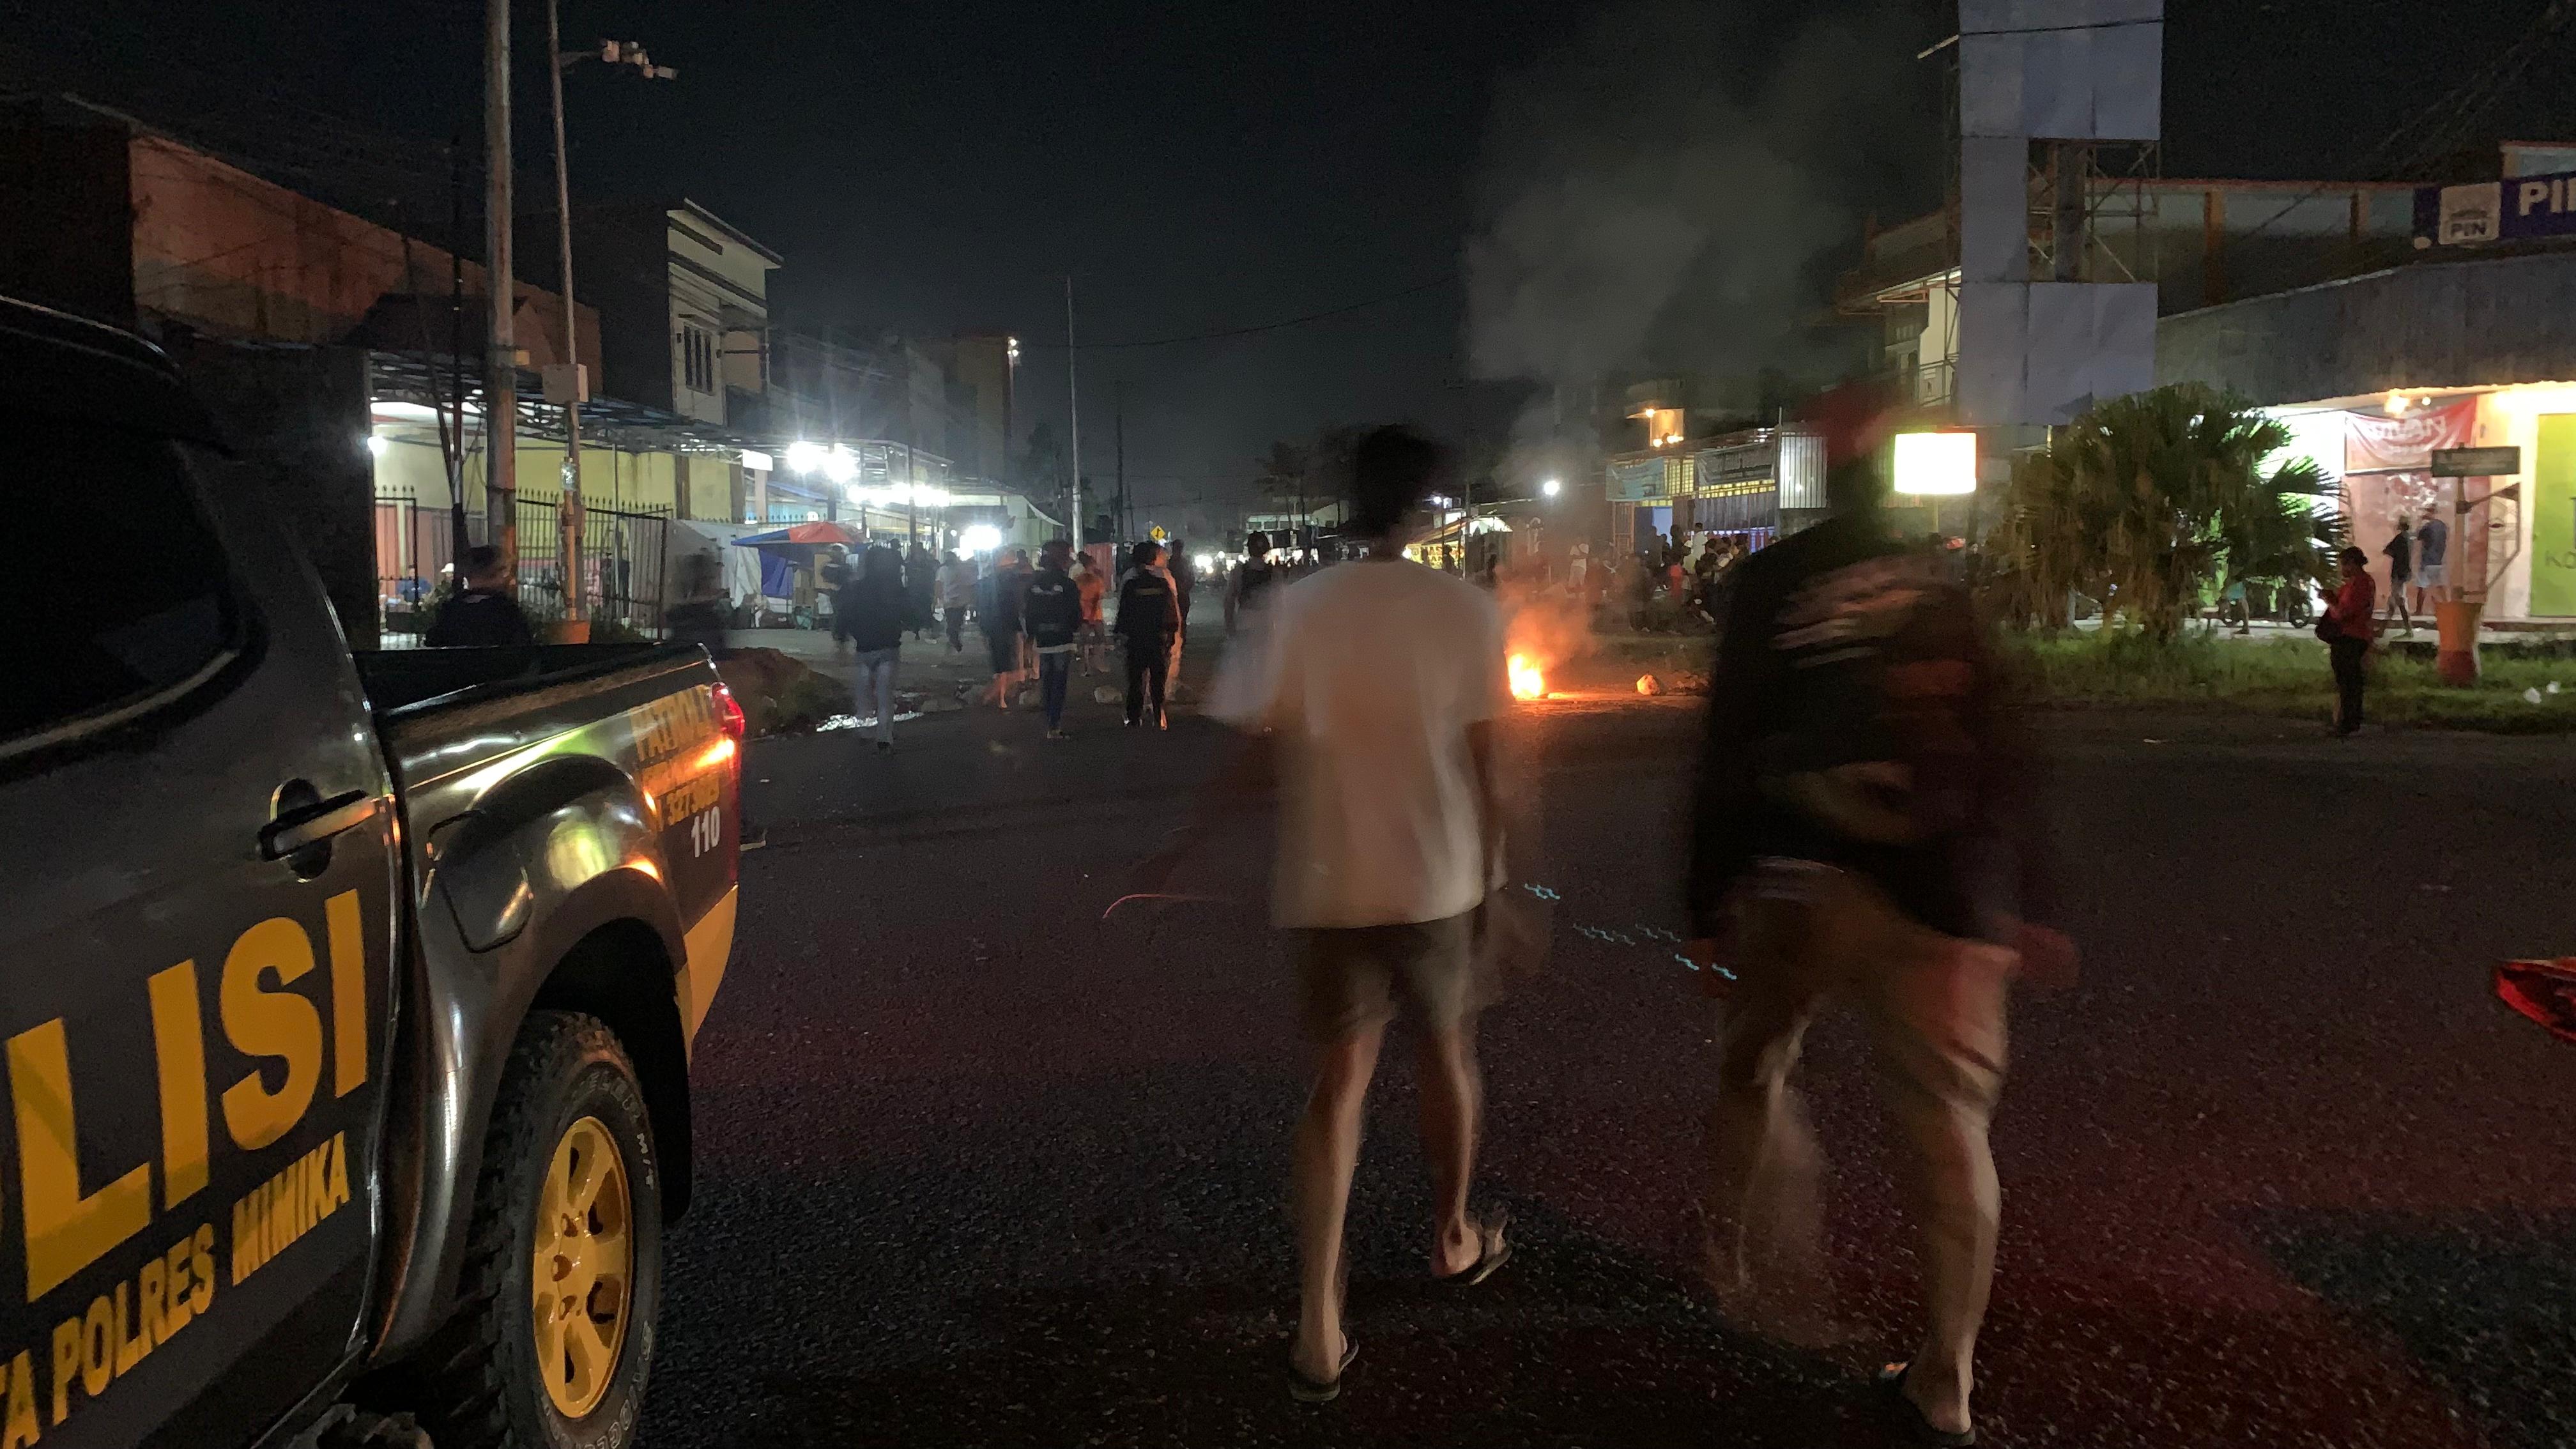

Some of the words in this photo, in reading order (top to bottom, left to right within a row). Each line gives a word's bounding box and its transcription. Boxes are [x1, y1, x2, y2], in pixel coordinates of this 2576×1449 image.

[691, 806, 721, 858] 110
[0, 889, 368, 1303] LISI
[51, 1222, 215, 1427] POLRES
[232, 1130, 350, 1287] MIMIKA
